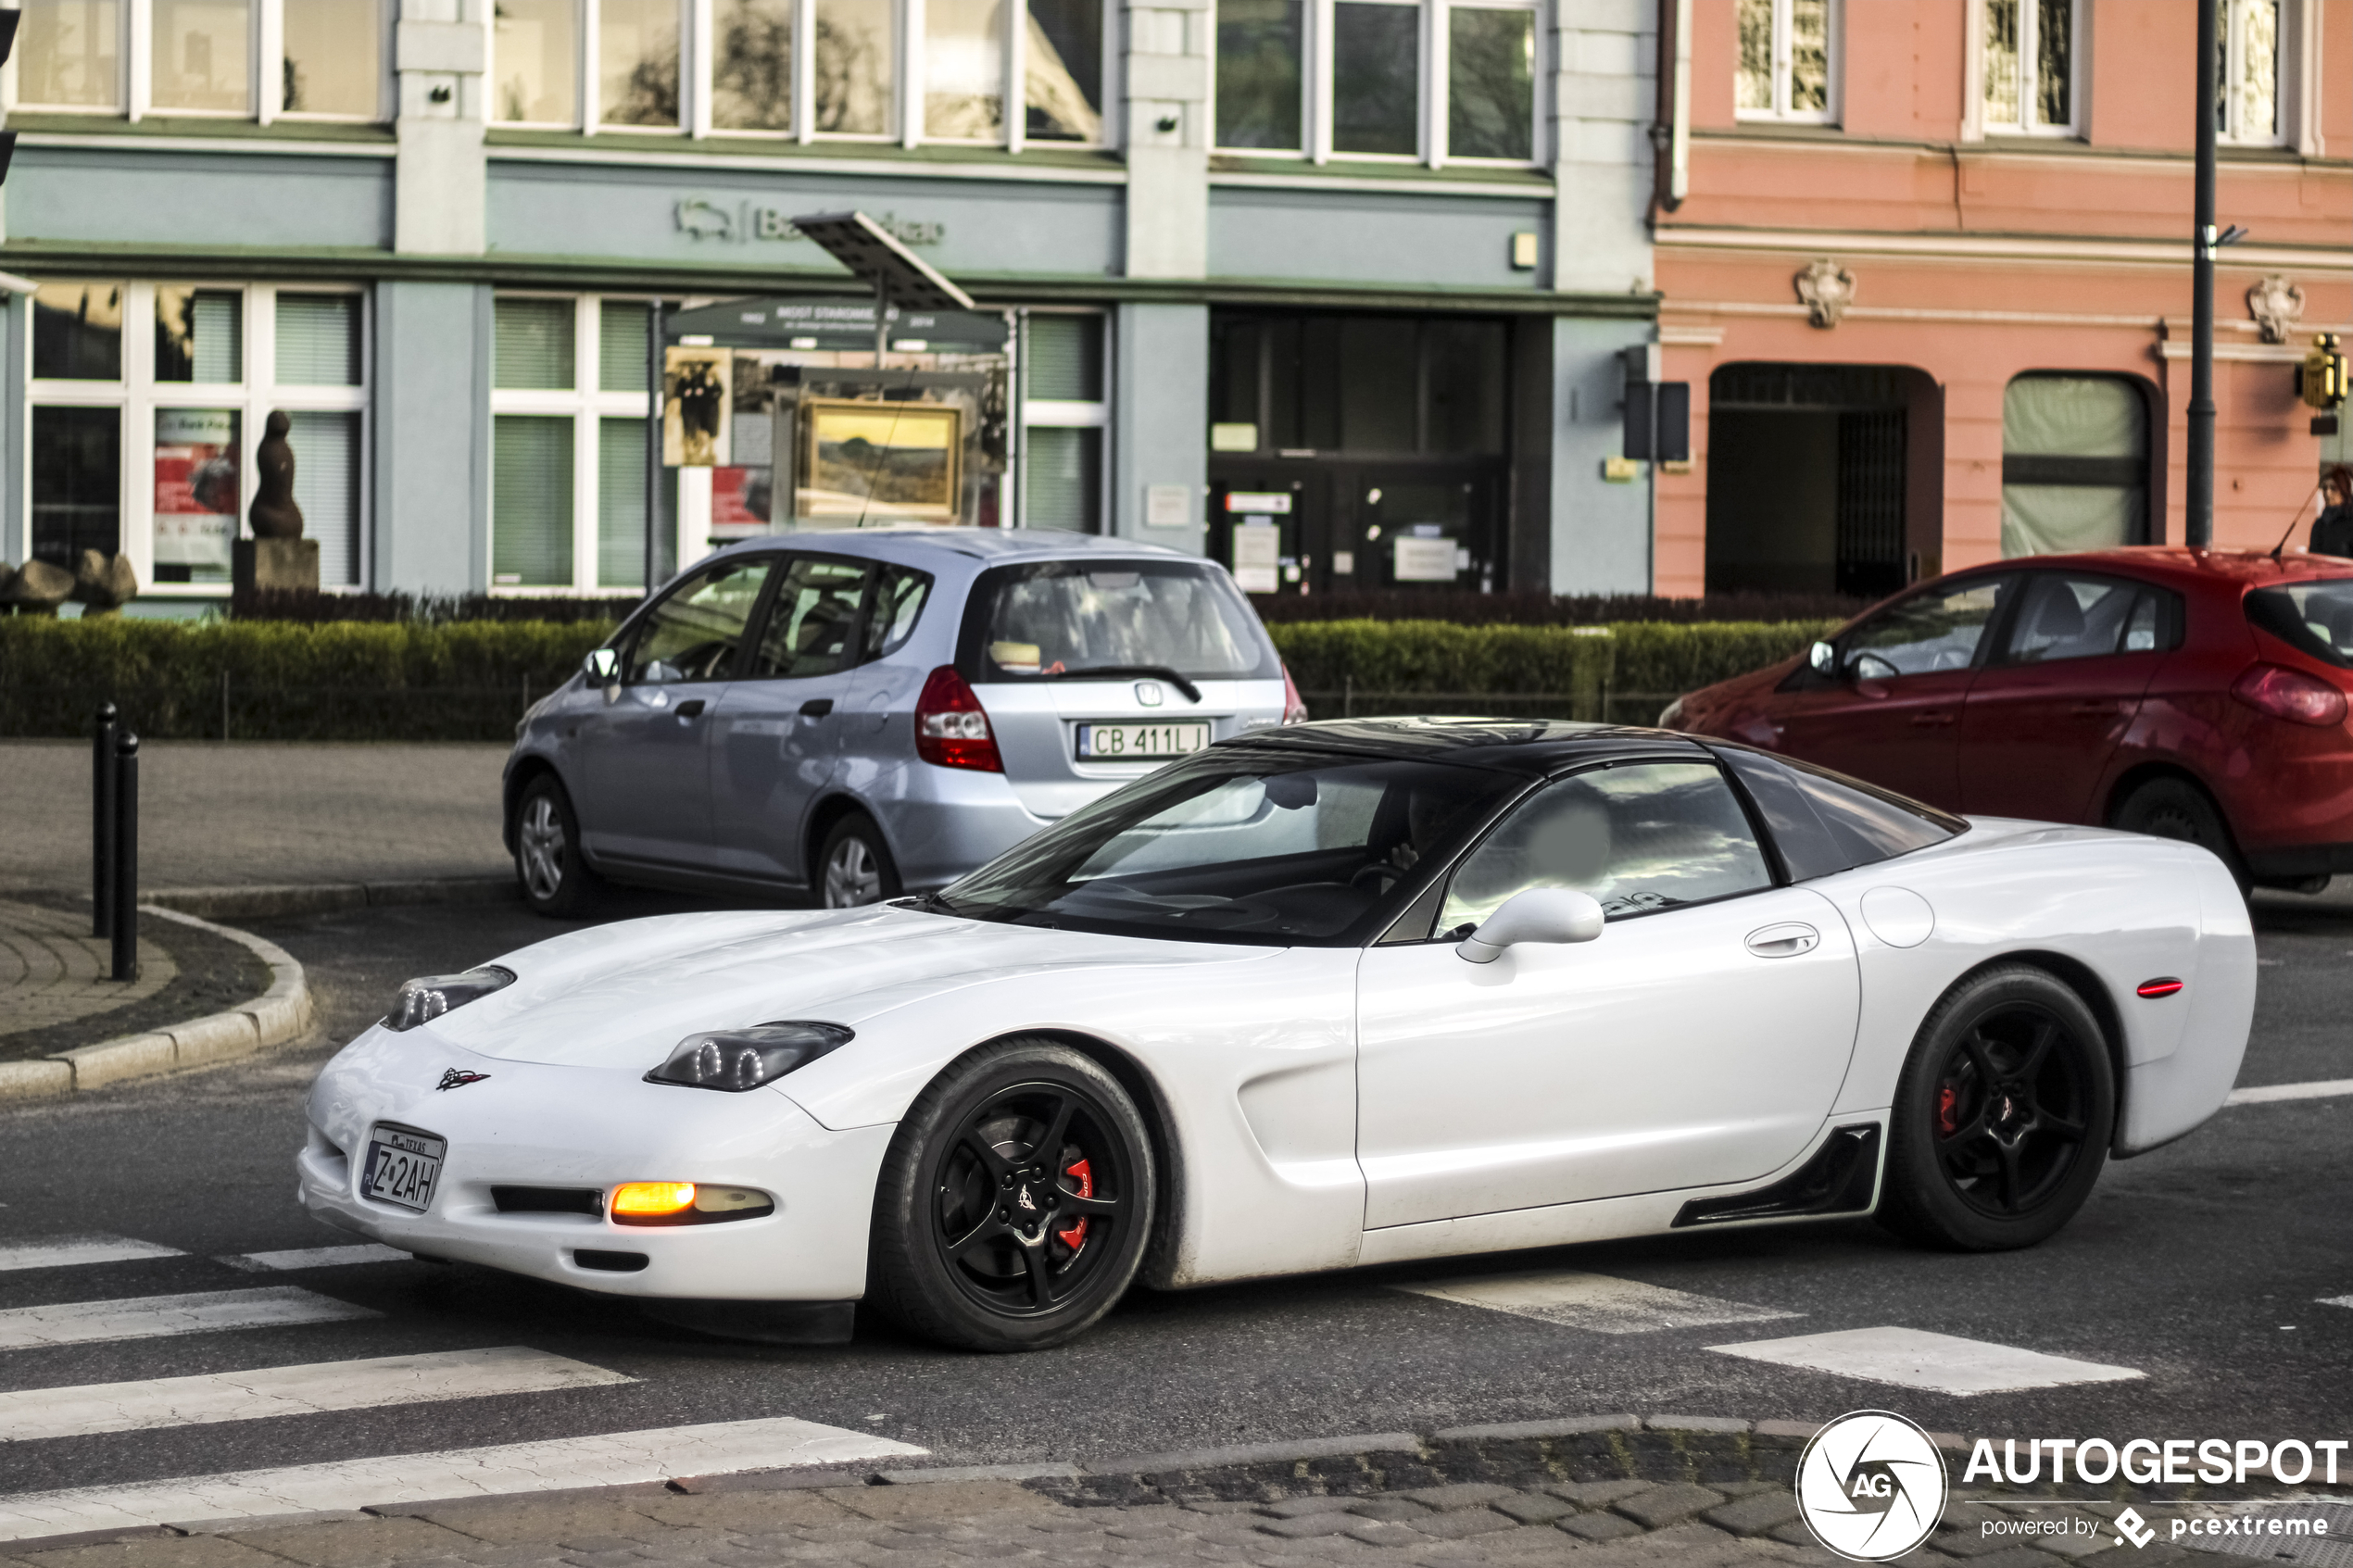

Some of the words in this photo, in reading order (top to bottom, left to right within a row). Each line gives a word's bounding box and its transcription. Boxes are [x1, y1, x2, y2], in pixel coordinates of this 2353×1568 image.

[813, 307, 900, 321] STAROMIEKI
[1095, 729, 1125, 754] CB
[1135, 727, 1201, 753] 411LJ
[406, 1138, 426, 1153] TEXAS
[364, 1173, 372, 1185] PL
